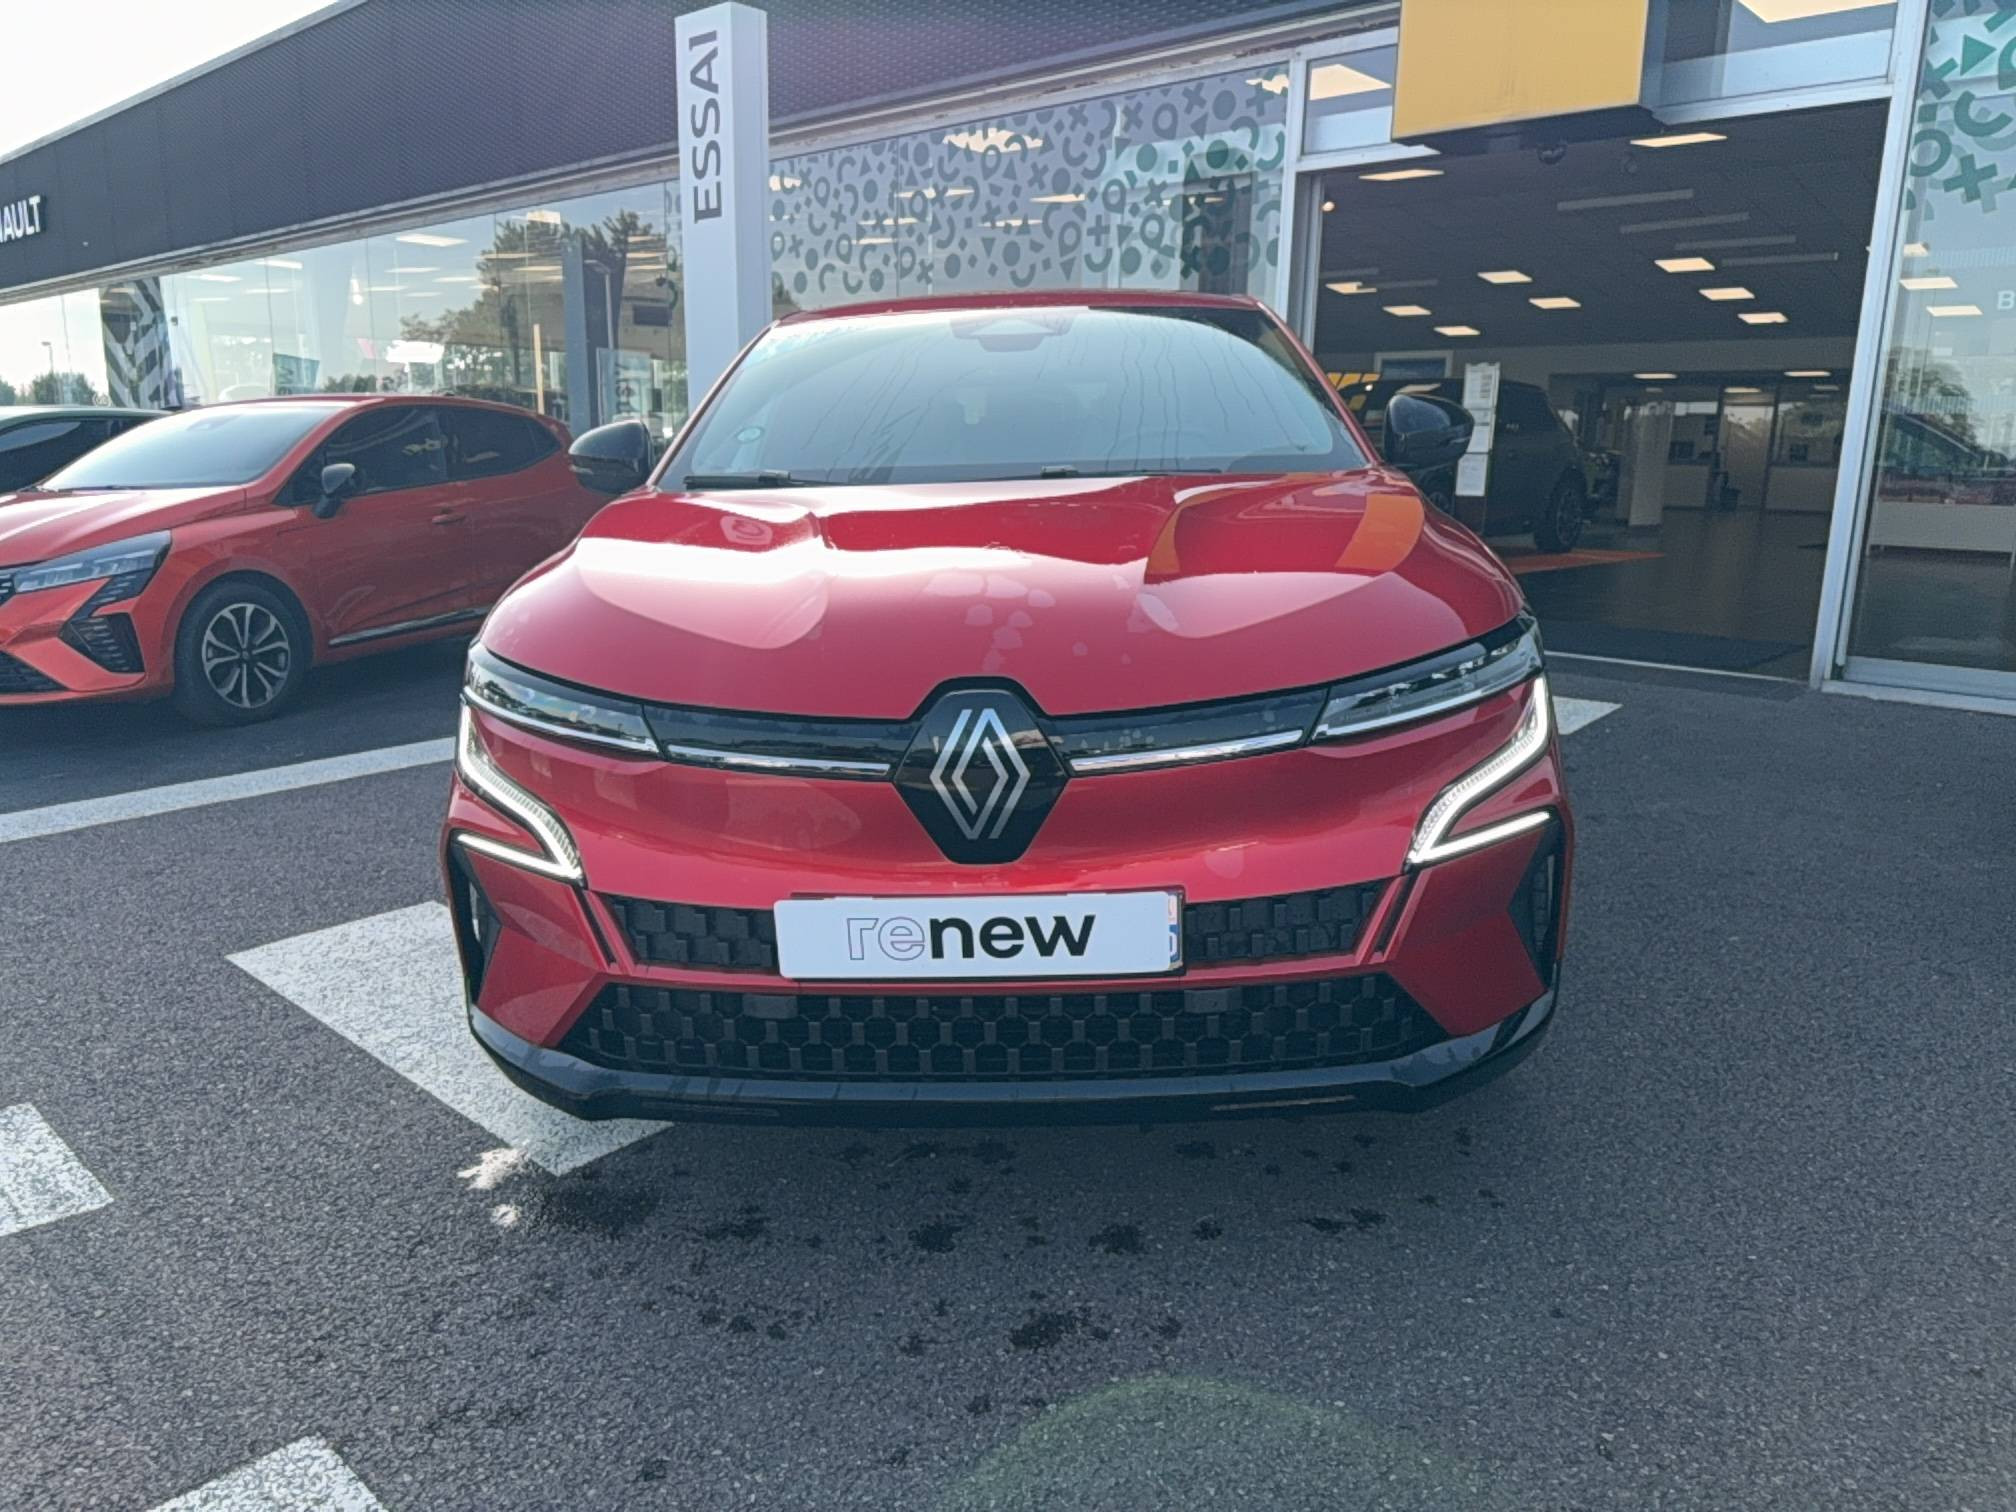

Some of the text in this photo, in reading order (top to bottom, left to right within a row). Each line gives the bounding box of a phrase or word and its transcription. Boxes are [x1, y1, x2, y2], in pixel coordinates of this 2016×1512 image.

[689, 30, 723, 224] ESSAI
[0, 195, 41, 242] AULT
[847, 914, 1096, 961] renew
